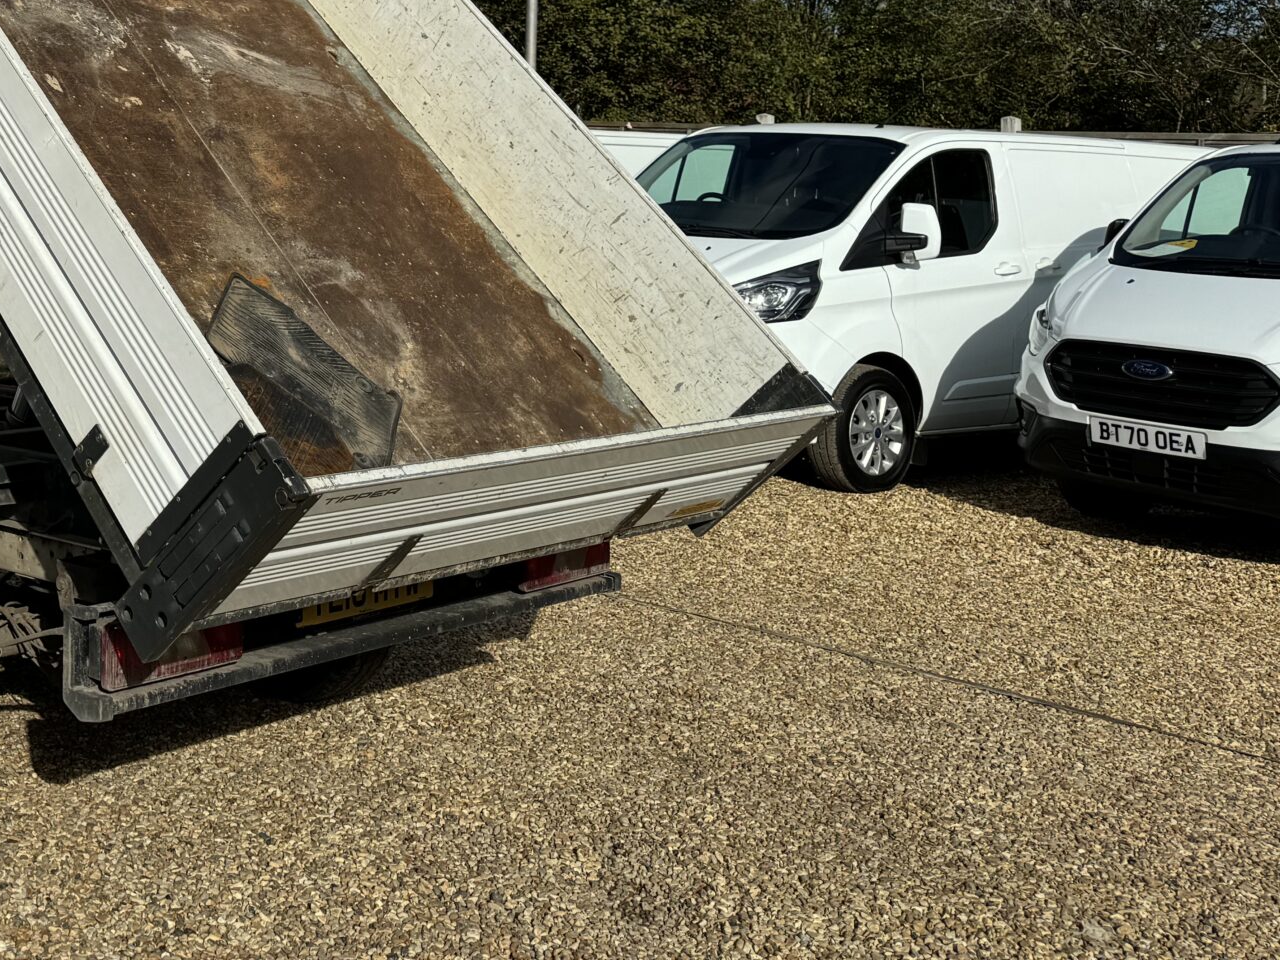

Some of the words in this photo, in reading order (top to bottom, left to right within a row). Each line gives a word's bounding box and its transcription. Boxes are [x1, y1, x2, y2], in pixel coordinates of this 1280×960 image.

[1099, 422, 1149, 447] BT70
[1155, 431, 1197, 454] OEA
[325, 487, 402, 505] TIPPER
